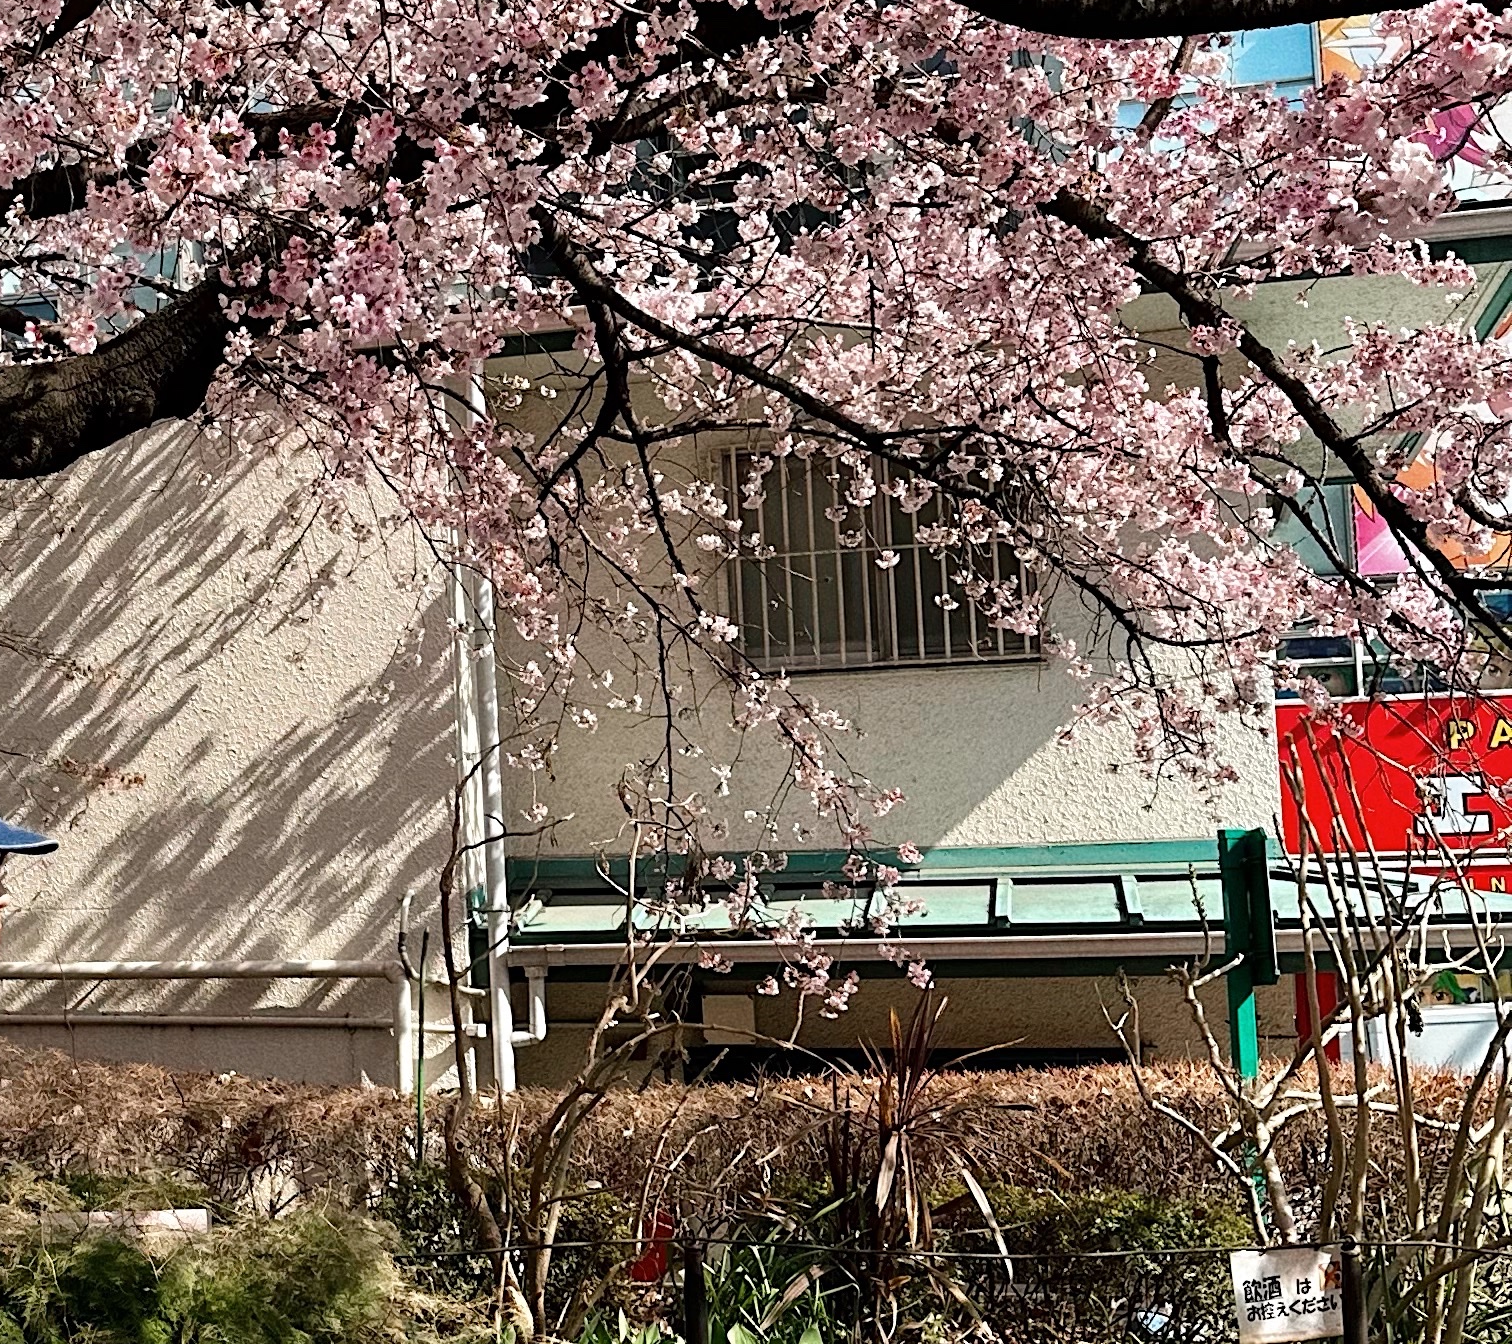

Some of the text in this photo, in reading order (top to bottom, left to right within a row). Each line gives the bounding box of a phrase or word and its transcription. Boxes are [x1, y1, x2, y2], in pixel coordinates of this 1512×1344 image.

[1246, 1294, 1342, 1322] お控えください
